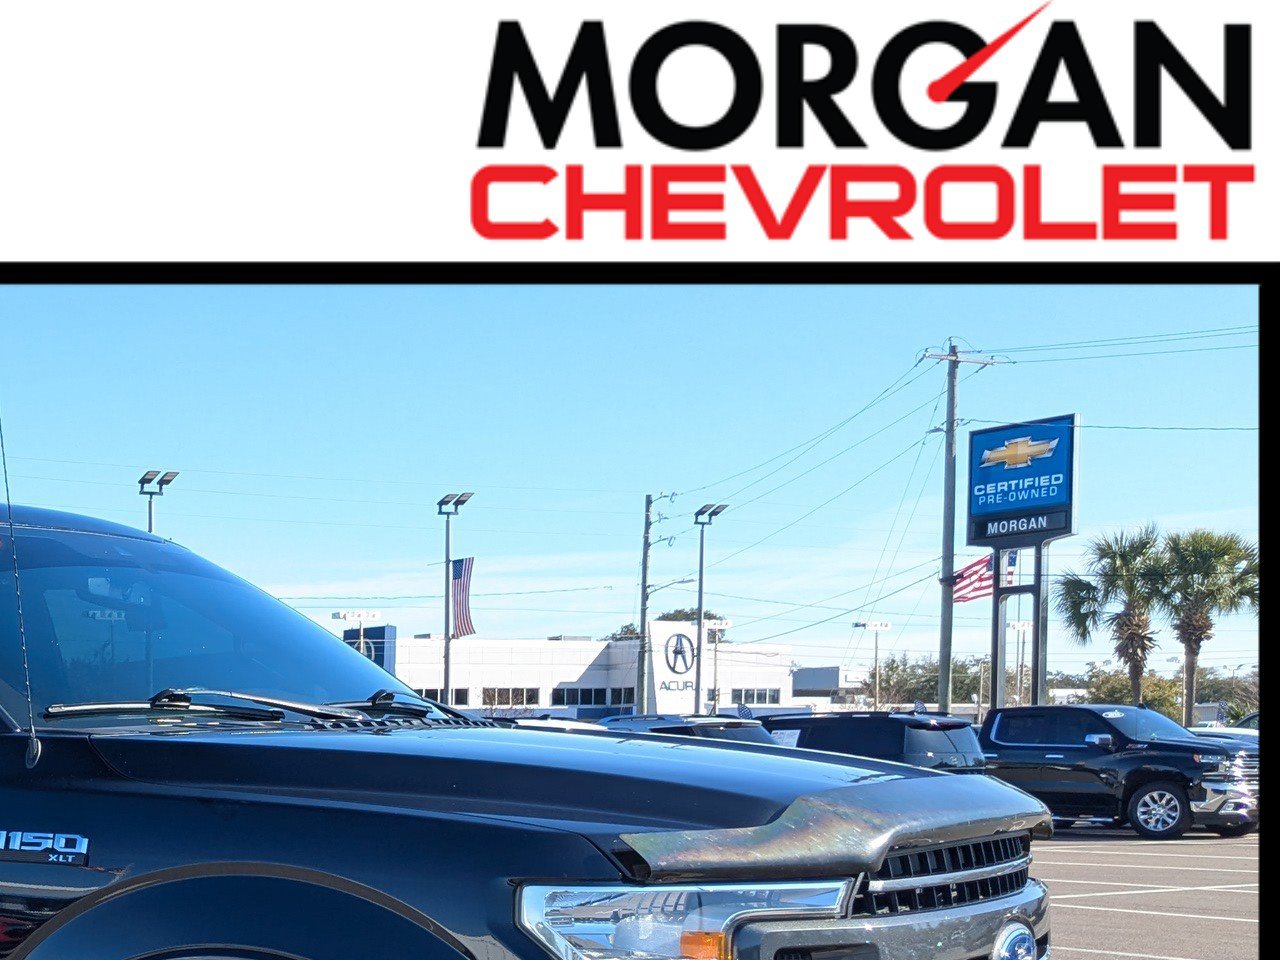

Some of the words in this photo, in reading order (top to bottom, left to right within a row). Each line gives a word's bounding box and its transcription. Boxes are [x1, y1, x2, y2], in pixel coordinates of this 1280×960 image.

[973, 473, 1064, 496] CERTIFIED
[978, 486, 1058, 506] PRE-OWNED
[986, 516, 1048, 535] MORGAN
[660, 680, 703, 691] ACUR
[48, 853, 76, 863] XLT
